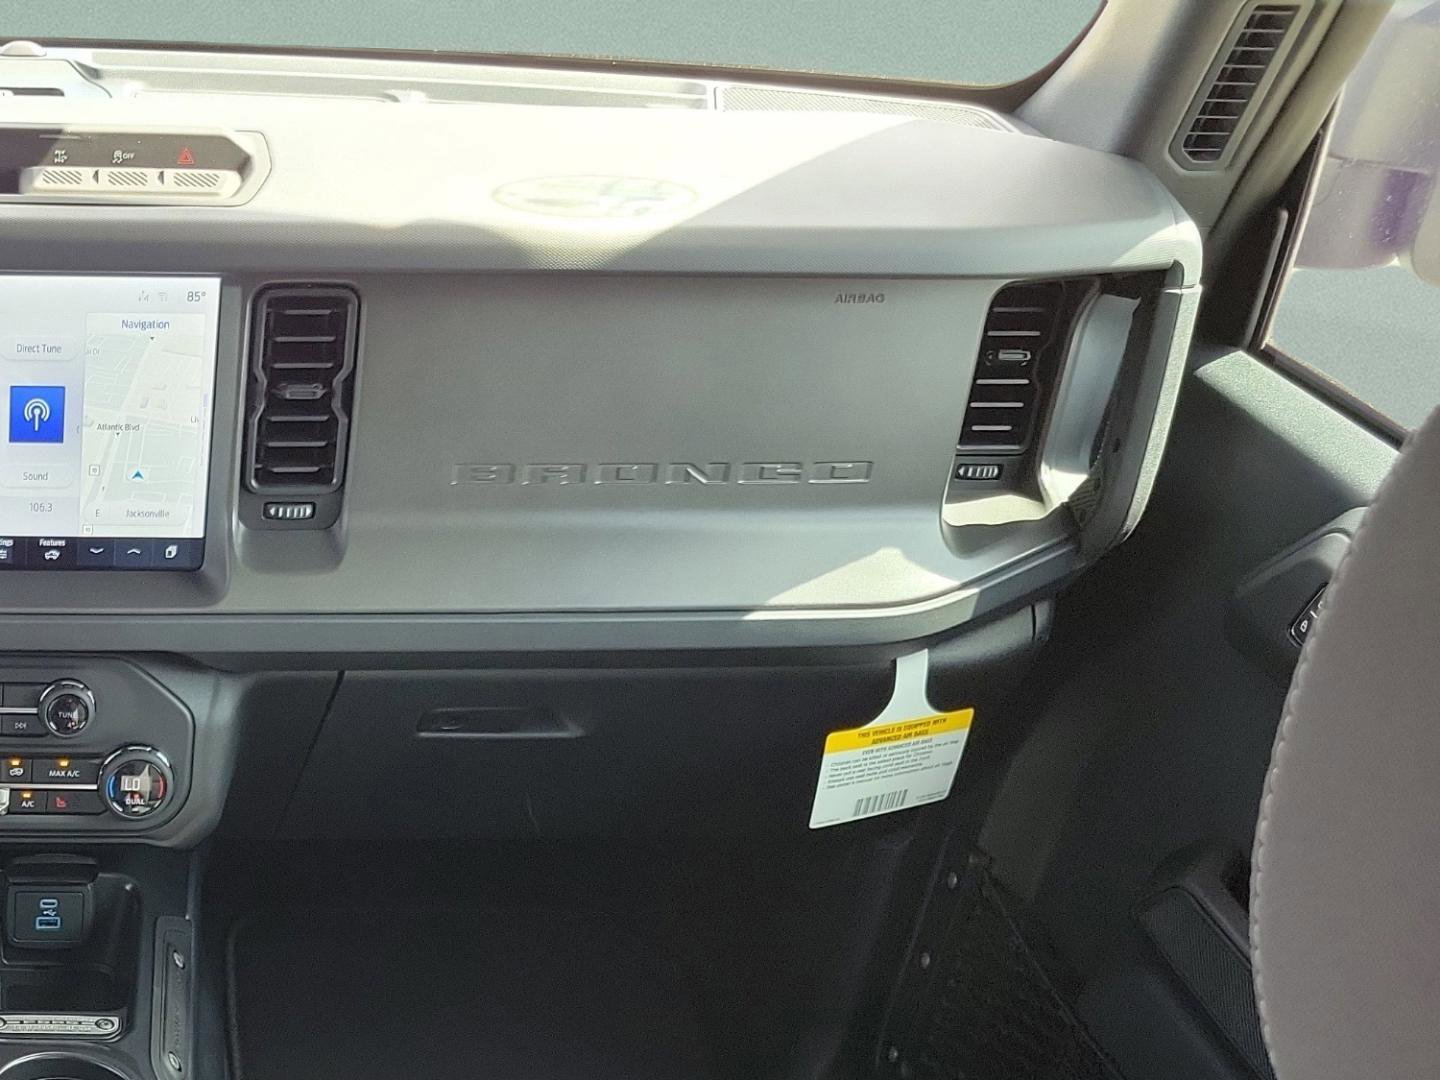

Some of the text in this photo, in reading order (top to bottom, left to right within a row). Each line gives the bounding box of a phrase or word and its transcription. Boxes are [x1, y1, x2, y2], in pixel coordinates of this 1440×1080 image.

[186, 290, 207, 302] 85°
[121, 318, 170, 331] Navigation
[16, 343, 62, 354] Direct Tune
[96, 422, 124, 432] Atlantic
[22, 471, 48, 482] Sound
[449, 460, 874, 486] BRONCO
[39, 538, 66, 547] Features
[66, 770, 80, 778] A/C
[124, 778, 140, 791] LO
